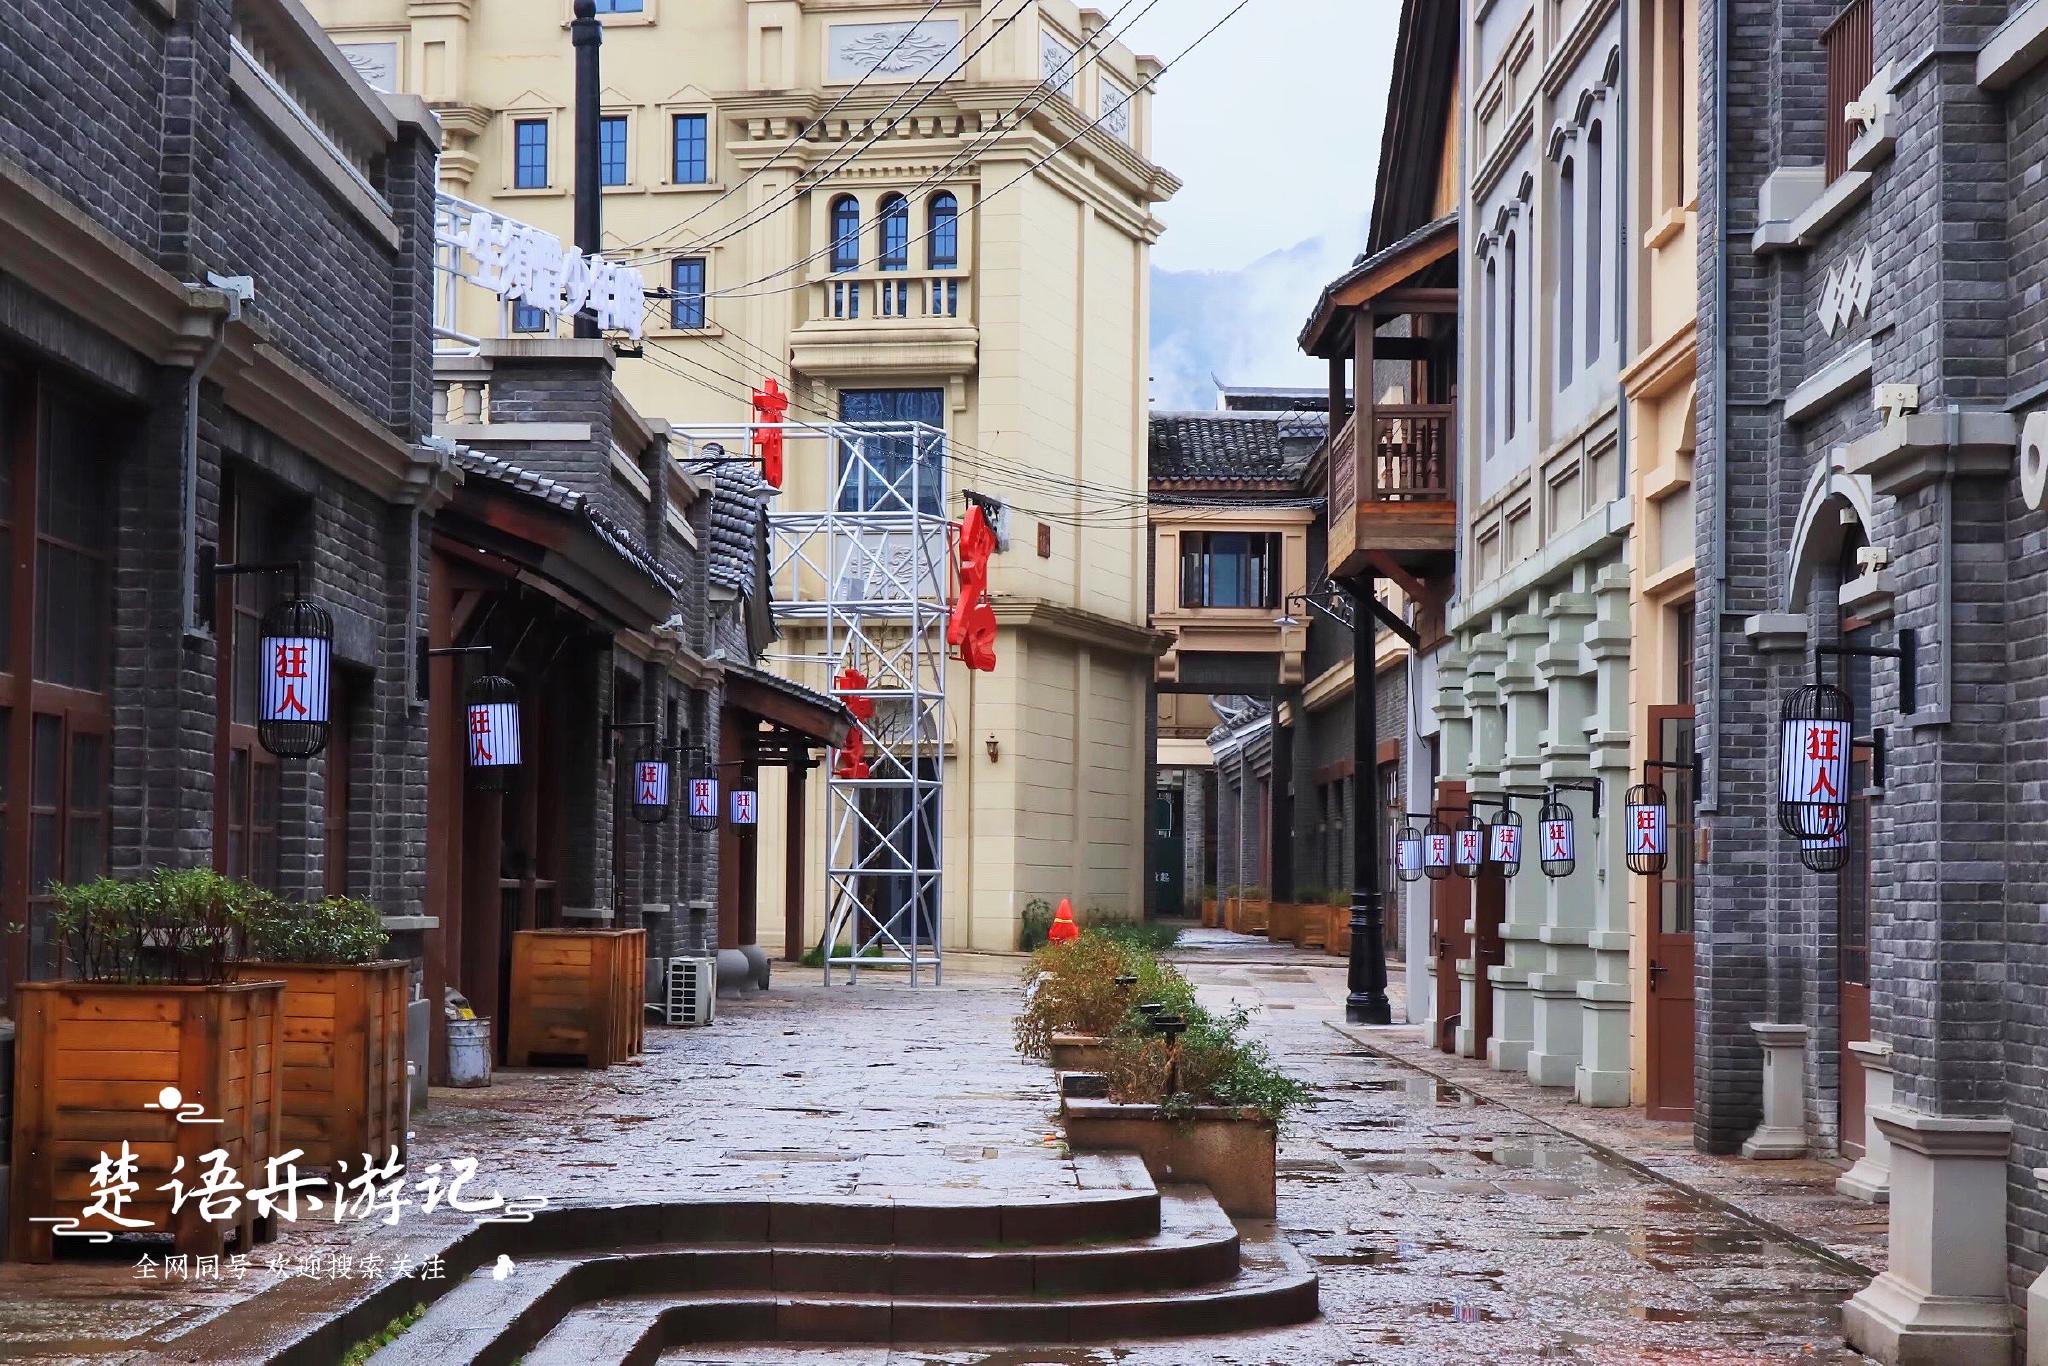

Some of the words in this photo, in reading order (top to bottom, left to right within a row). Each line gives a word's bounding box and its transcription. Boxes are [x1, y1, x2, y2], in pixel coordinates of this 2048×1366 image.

[275, 645, 308, 716] 狂人
[471, 710, 492, 760] 狂人
[1807, 727, 1840, 798] 狂人
[641, 765, 657, 801] 狂人
[695, 782, 709, 813] 狂人
[737, 793, 751, 821] 狂人
[1463, 833, 1476, 862] 狂人
[1500, 828, 1514, 860] 狂人
[1549, 823, 1567, 858] 狂人
[1637, 810, 1656, 851] 狂人
[1433, 838, 1445, 864] 狂人
